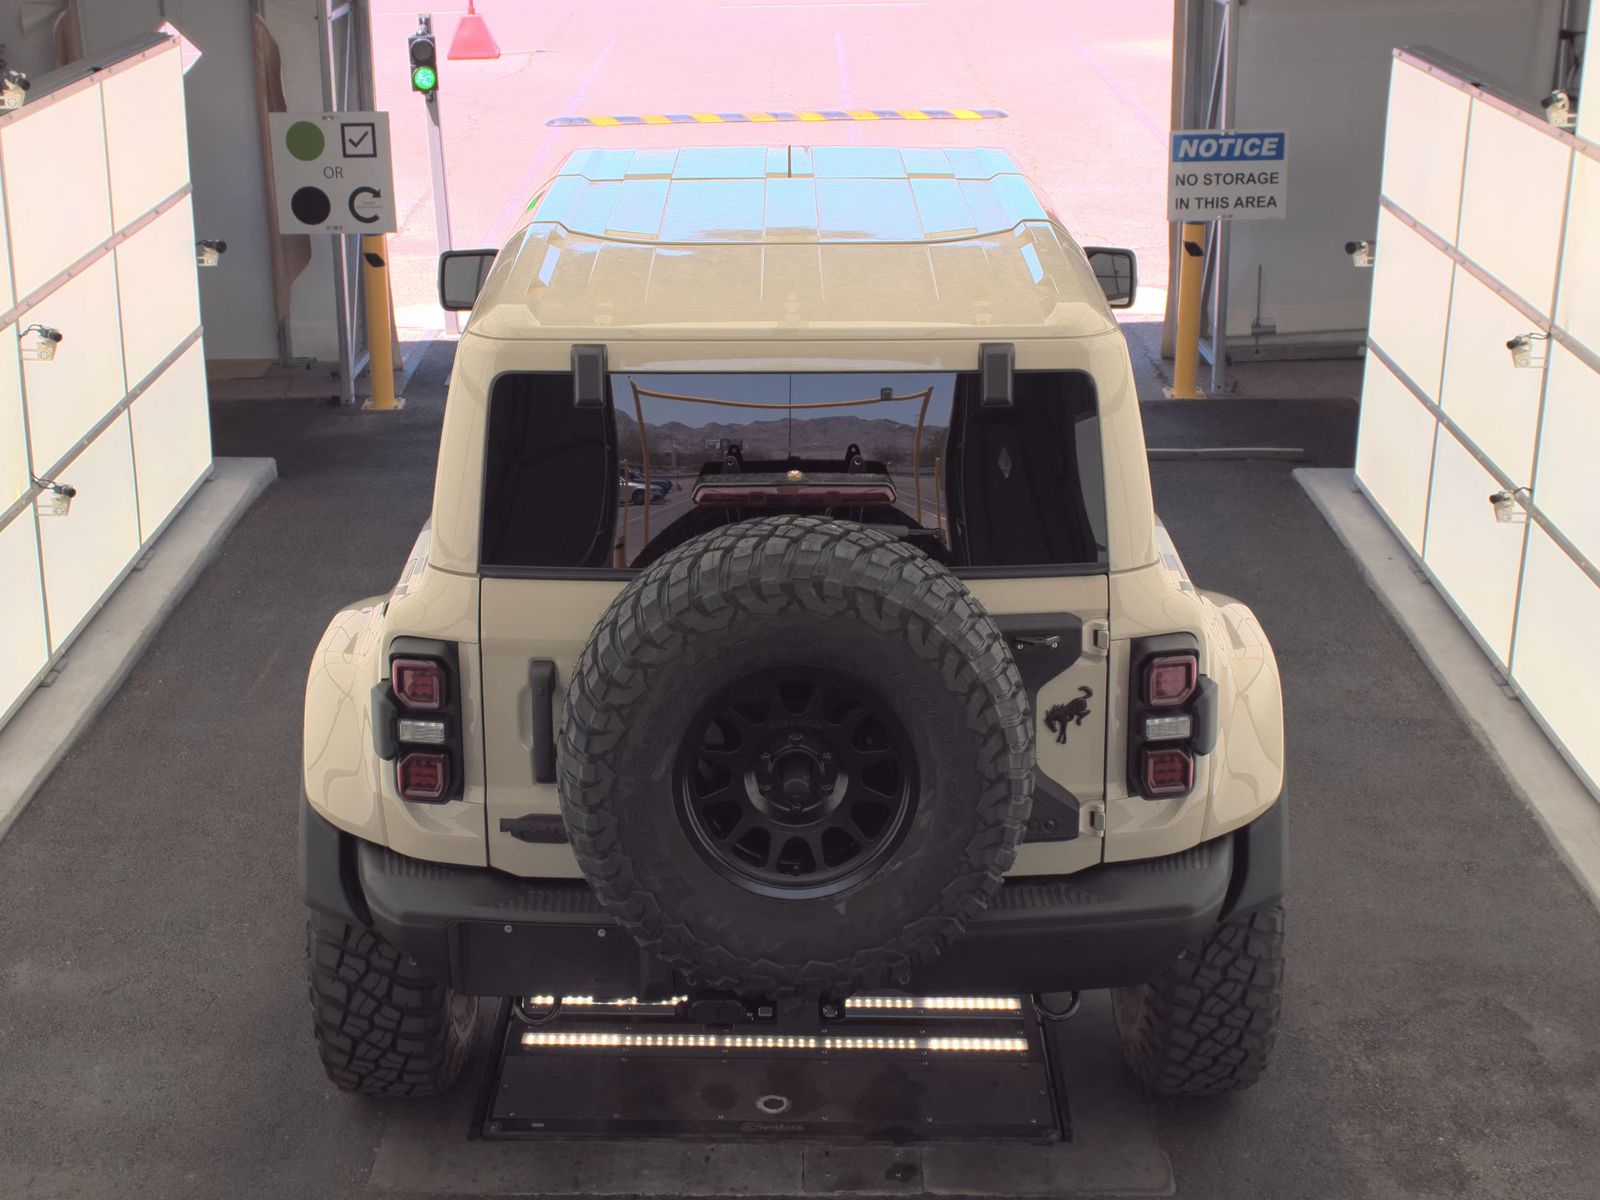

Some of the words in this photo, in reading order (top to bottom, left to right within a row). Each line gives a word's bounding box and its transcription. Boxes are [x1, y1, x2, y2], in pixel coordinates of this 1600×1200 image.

[1178, 137, 1279, 158] NOTICE
[323, 166, 344, 179] OR
[1175, 173, 1199, 187] NO
[1203, 171, 1280, 186] STORAGE
[1175, 197, 1190, 210] IN
[1194, 196, 1230, 209] THIS
[1233, 195, 1278, 209] AREA
